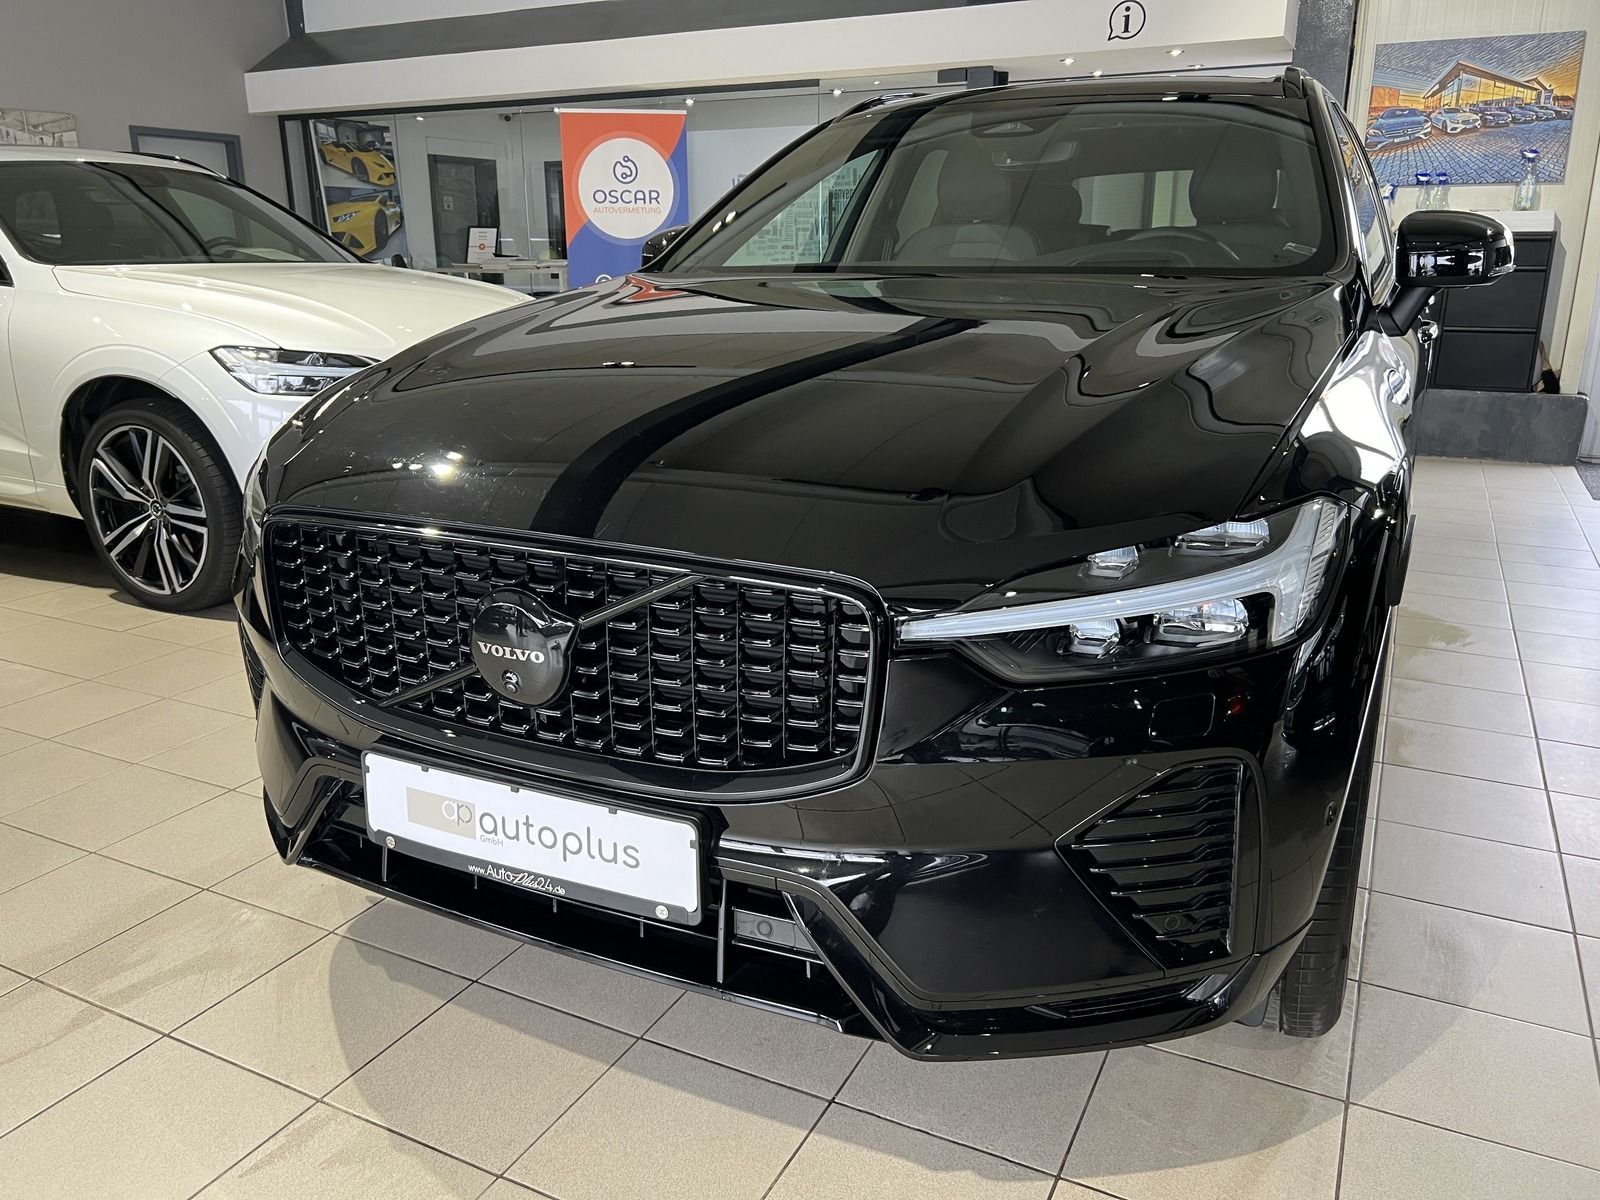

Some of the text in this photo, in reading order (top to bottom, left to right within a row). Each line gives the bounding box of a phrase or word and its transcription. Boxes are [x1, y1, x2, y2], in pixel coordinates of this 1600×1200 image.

[593, 189, 661, 205] OSCAR
[593, 206, 662, 214] AUTOVERMIETUNG
[477, 641, 545, 663] VOLVO
[479, 812, 640, 869] autoplus
[480, 834, 503, 847] GmbH
